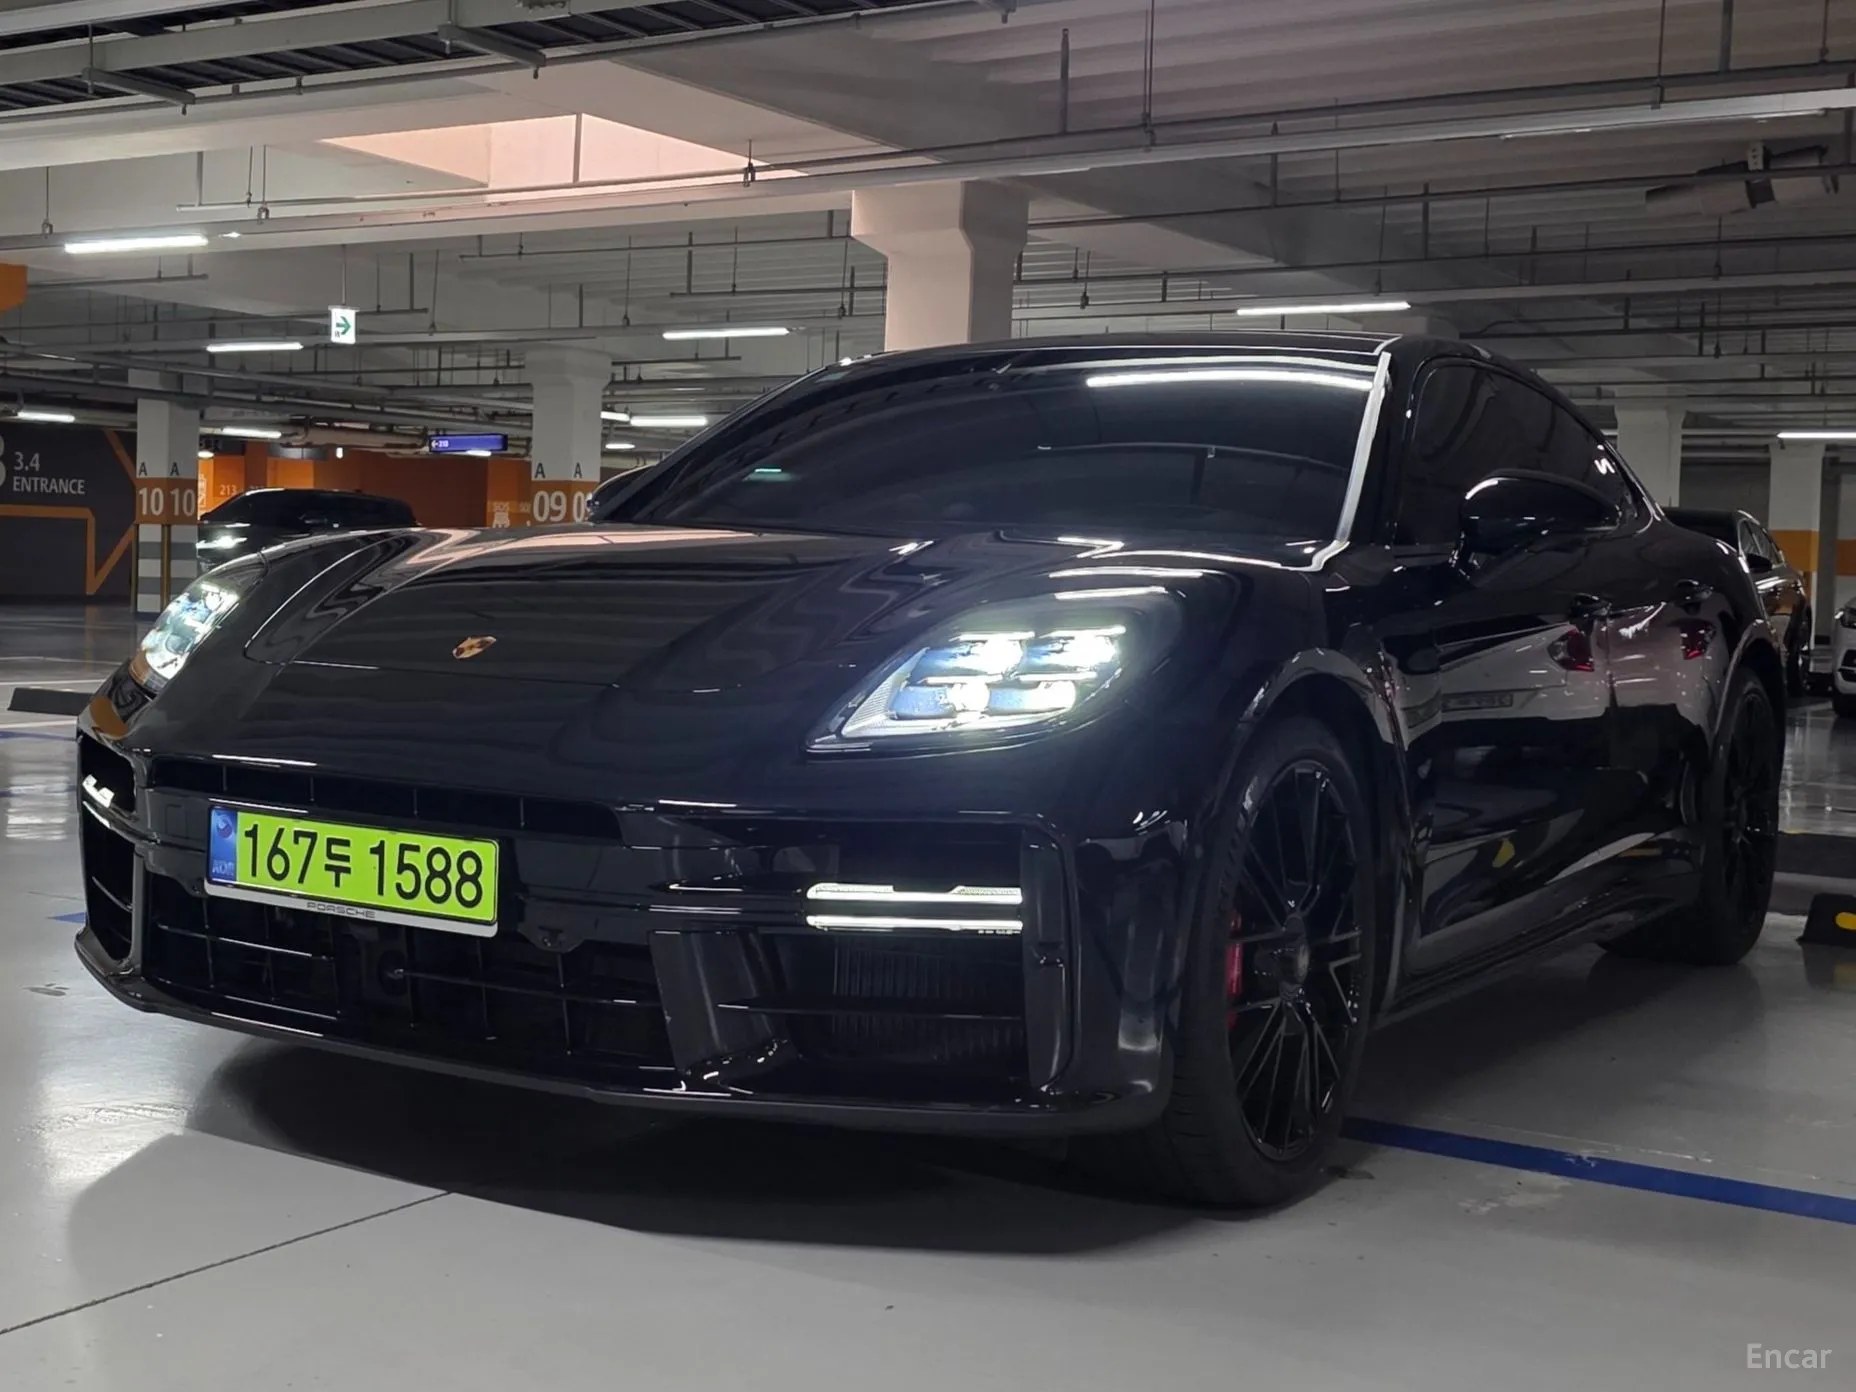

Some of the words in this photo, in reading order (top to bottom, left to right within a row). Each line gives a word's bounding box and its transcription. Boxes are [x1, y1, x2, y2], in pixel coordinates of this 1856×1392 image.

[13, 451, 41, 472] 3.4
[138, 461, 148, 477] A
[170, 461, 180, 477] A
[534, 462, 546, 479] A
[573, 461, 582, 479] A
[13, 476, 86, 495] ENTRANCE
[139, 487, 164, 517] 10
[170, 488, 196, 517] 10
[533, 490, 567, 522] 09
[572, 491, 589, 524] 0
[244, 823, 352, 888] 167두
[369, 839, 483, 909] 1588
[306, 901, 376, 918] PORSCHE
